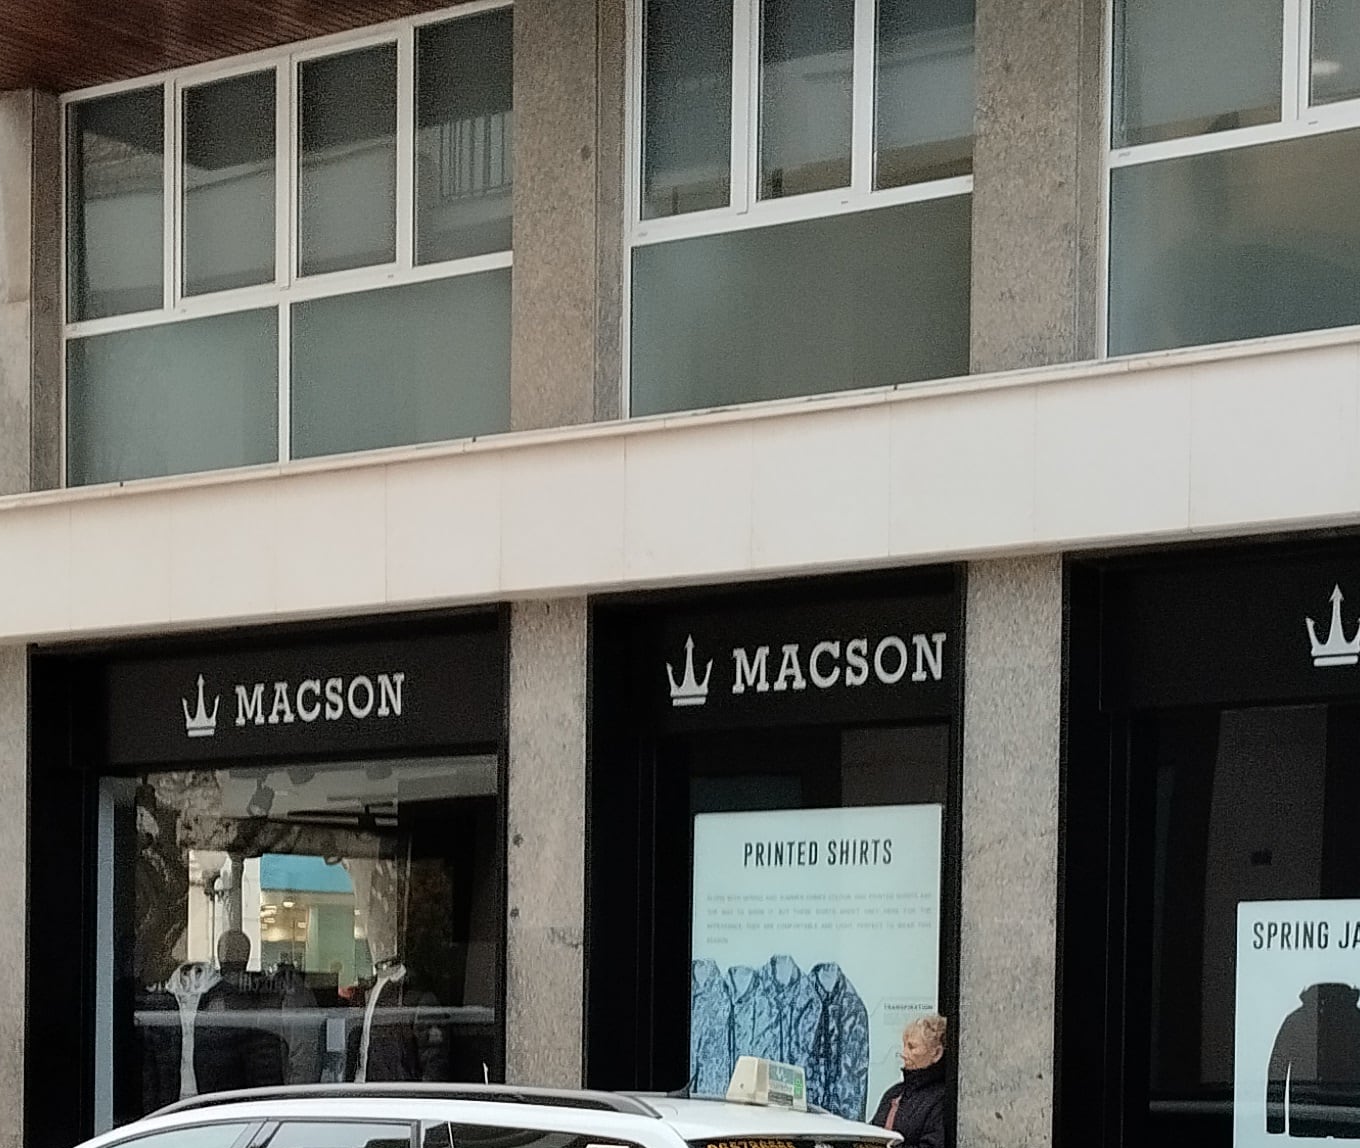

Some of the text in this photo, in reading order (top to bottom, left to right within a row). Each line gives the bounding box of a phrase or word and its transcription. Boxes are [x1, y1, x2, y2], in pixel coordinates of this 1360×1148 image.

[732, 632, 947, 694] MACSON
[235, 672, 404, 726] MACSON
[743, 838, 892, 867] PRINTED SHIRTS
[1252, 919, 1330, 951] SPRING
